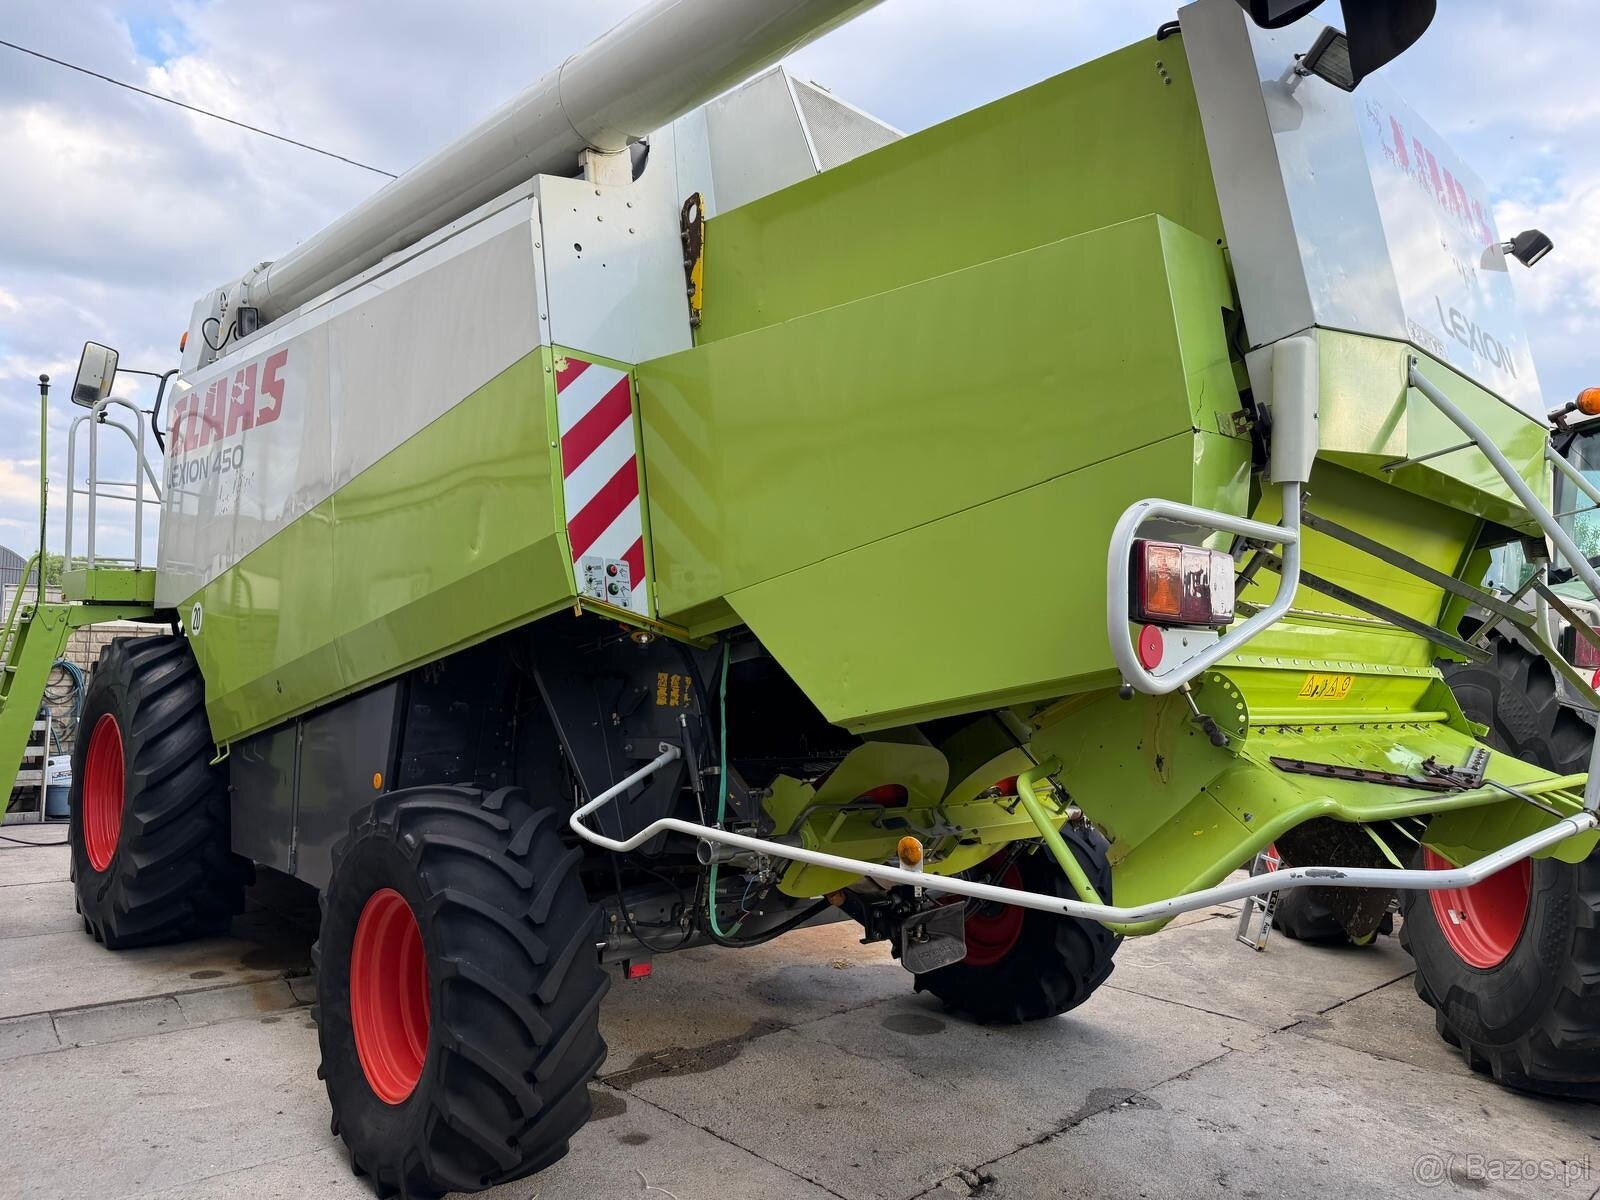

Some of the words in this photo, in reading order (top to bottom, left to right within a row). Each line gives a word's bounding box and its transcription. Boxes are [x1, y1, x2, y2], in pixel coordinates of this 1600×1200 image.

[1434, 295, 1517, 380] LEXION
[167, 455, 209, 489] LEXION
[211, 444, 244, 475] 450
[192, 607, 201, 631] 20
